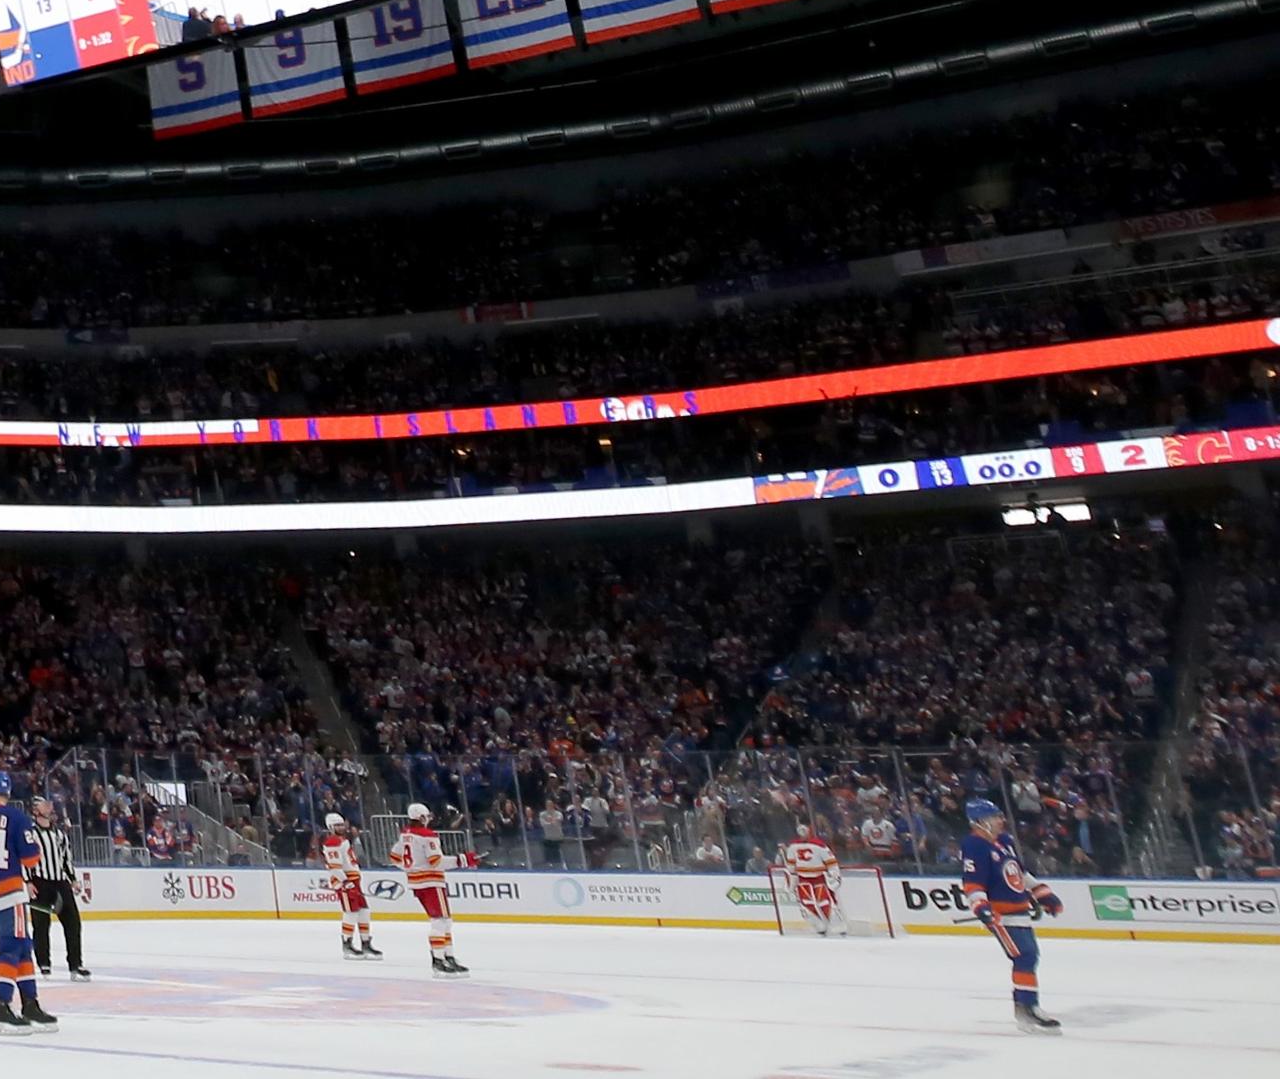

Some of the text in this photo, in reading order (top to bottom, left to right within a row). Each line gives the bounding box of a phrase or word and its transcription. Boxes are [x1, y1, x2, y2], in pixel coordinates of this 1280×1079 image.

[274, 26, 305, 69] 9
[197, 418, 321, 444] YORK
[374, 391, 698, 439] ISLANDERS
[1121, 444, 1147, 466] 2
[932, 469, 953, 487] 13
[978, 459, 1041, 481] 00.0
[187, 875, 236, 900] UBS
[293, 892, 341, 903] NHLSHO
[588, 884, 663, 896] GLOBALIZATION
[901, 880, 969, 912] bet
[591, 894, 662, 905] PARTNERS
[1106, 889, 1278, 916] enterprise
